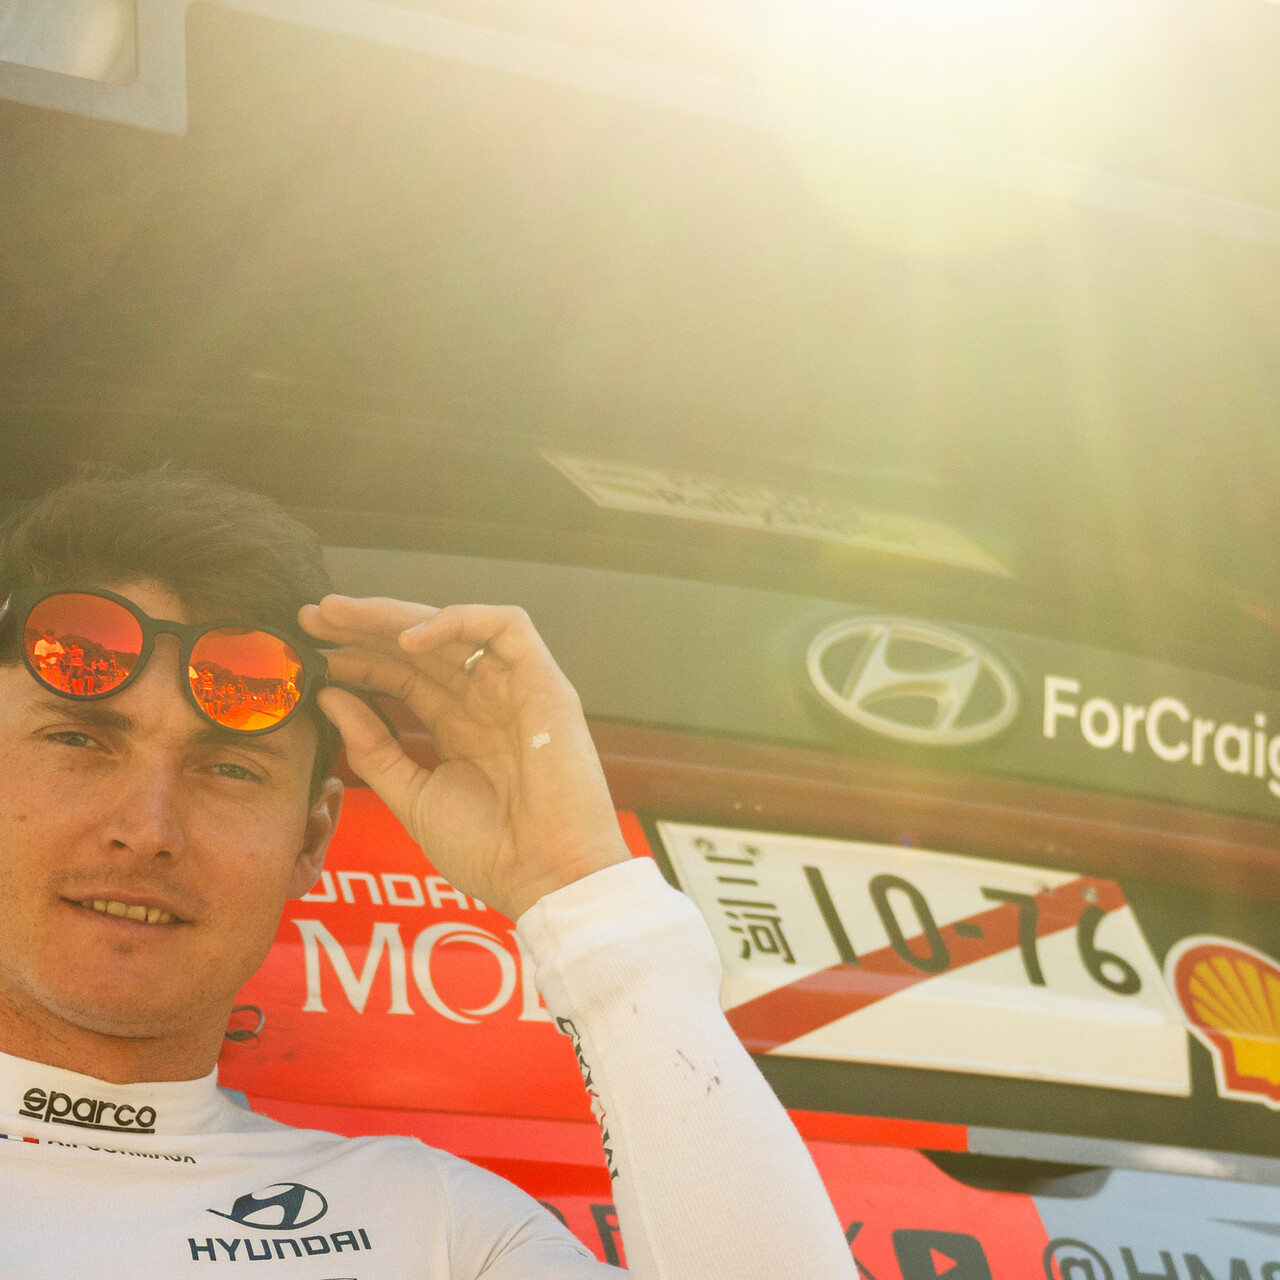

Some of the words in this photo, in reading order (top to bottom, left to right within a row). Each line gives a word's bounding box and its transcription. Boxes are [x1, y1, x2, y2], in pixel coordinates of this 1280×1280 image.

[802, 864, 1143, 996] 10-76
[18, 1087, 157, 1133] sparco
[187, 1228, 372, 1262] HYUNDAI
